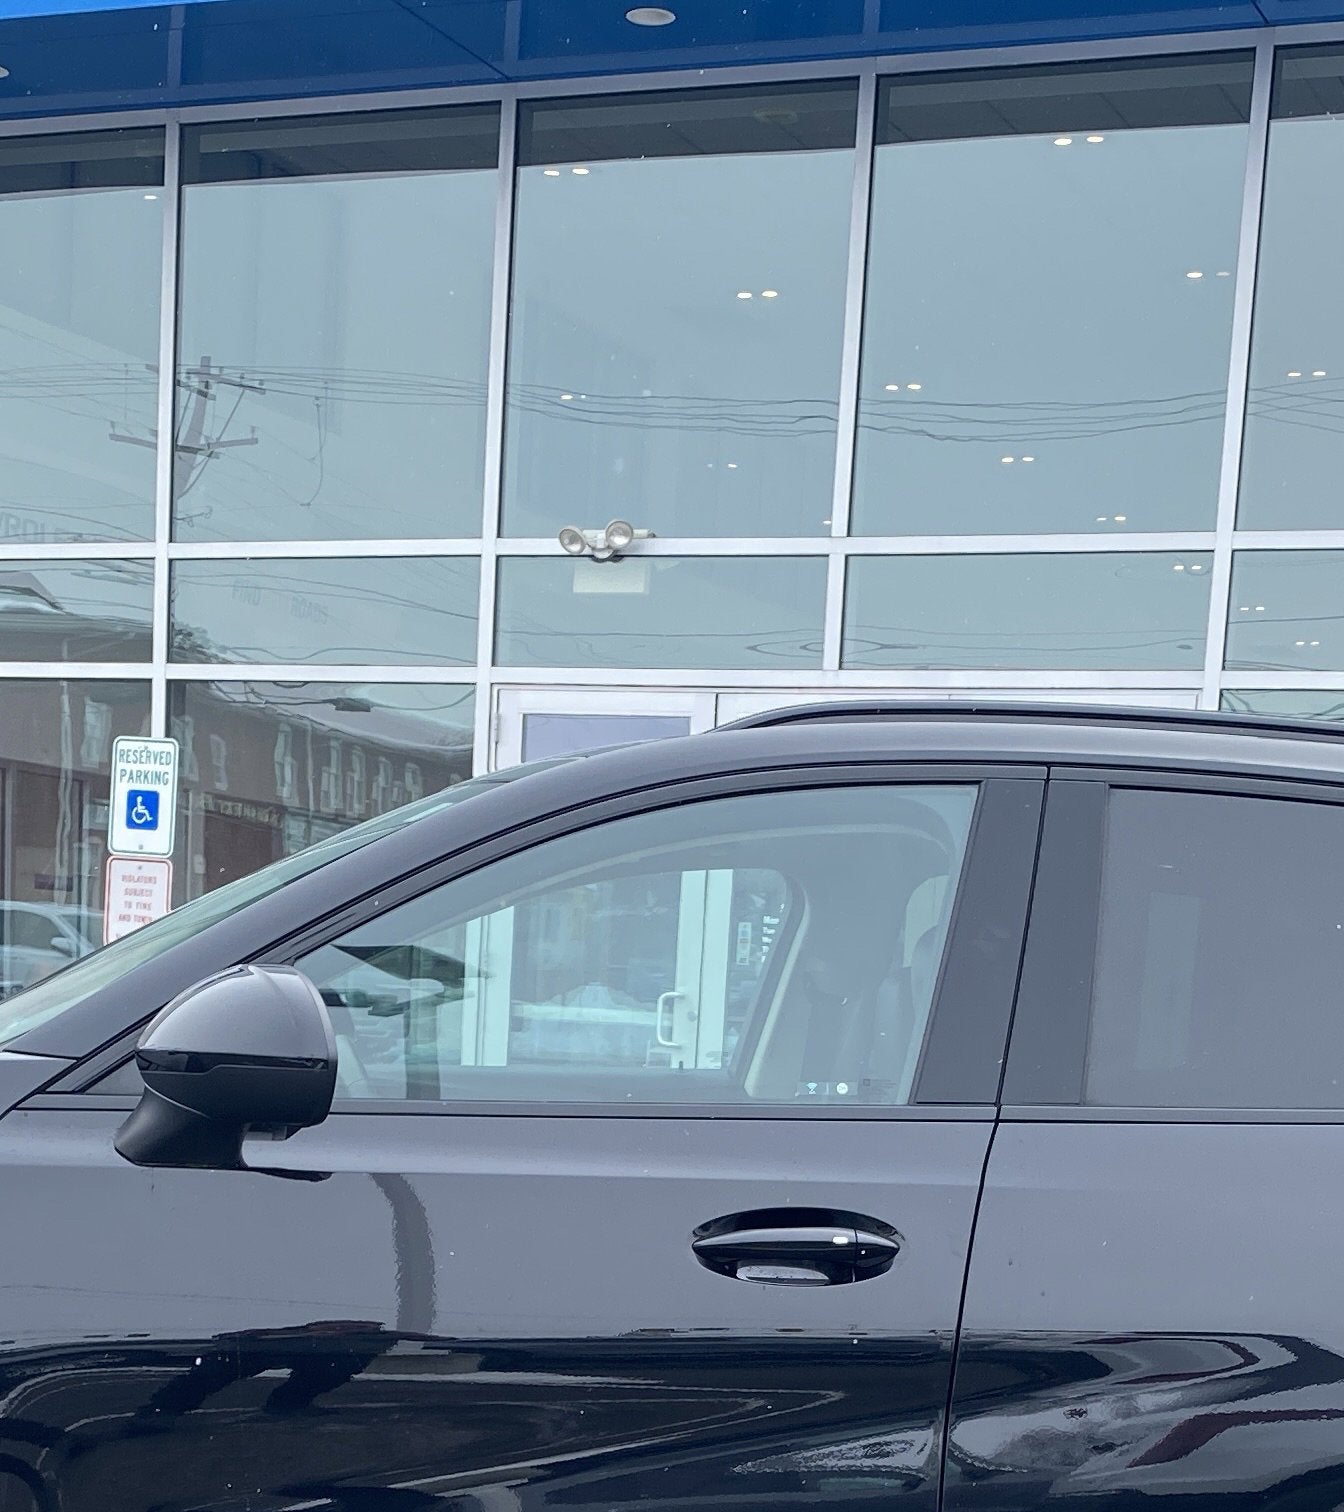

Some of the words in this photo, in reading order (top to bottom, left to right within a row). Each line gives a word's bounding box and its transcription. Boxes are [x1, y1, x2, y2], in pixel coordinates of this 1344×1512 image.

[119, 749, 172, 766] RESERVED
[119, 769, 170, 786] PARKING
[124, 888, 153, 897] SUBJECT
[124, 901, 133, 909] TO
[118, 913, 131, 922] AND
